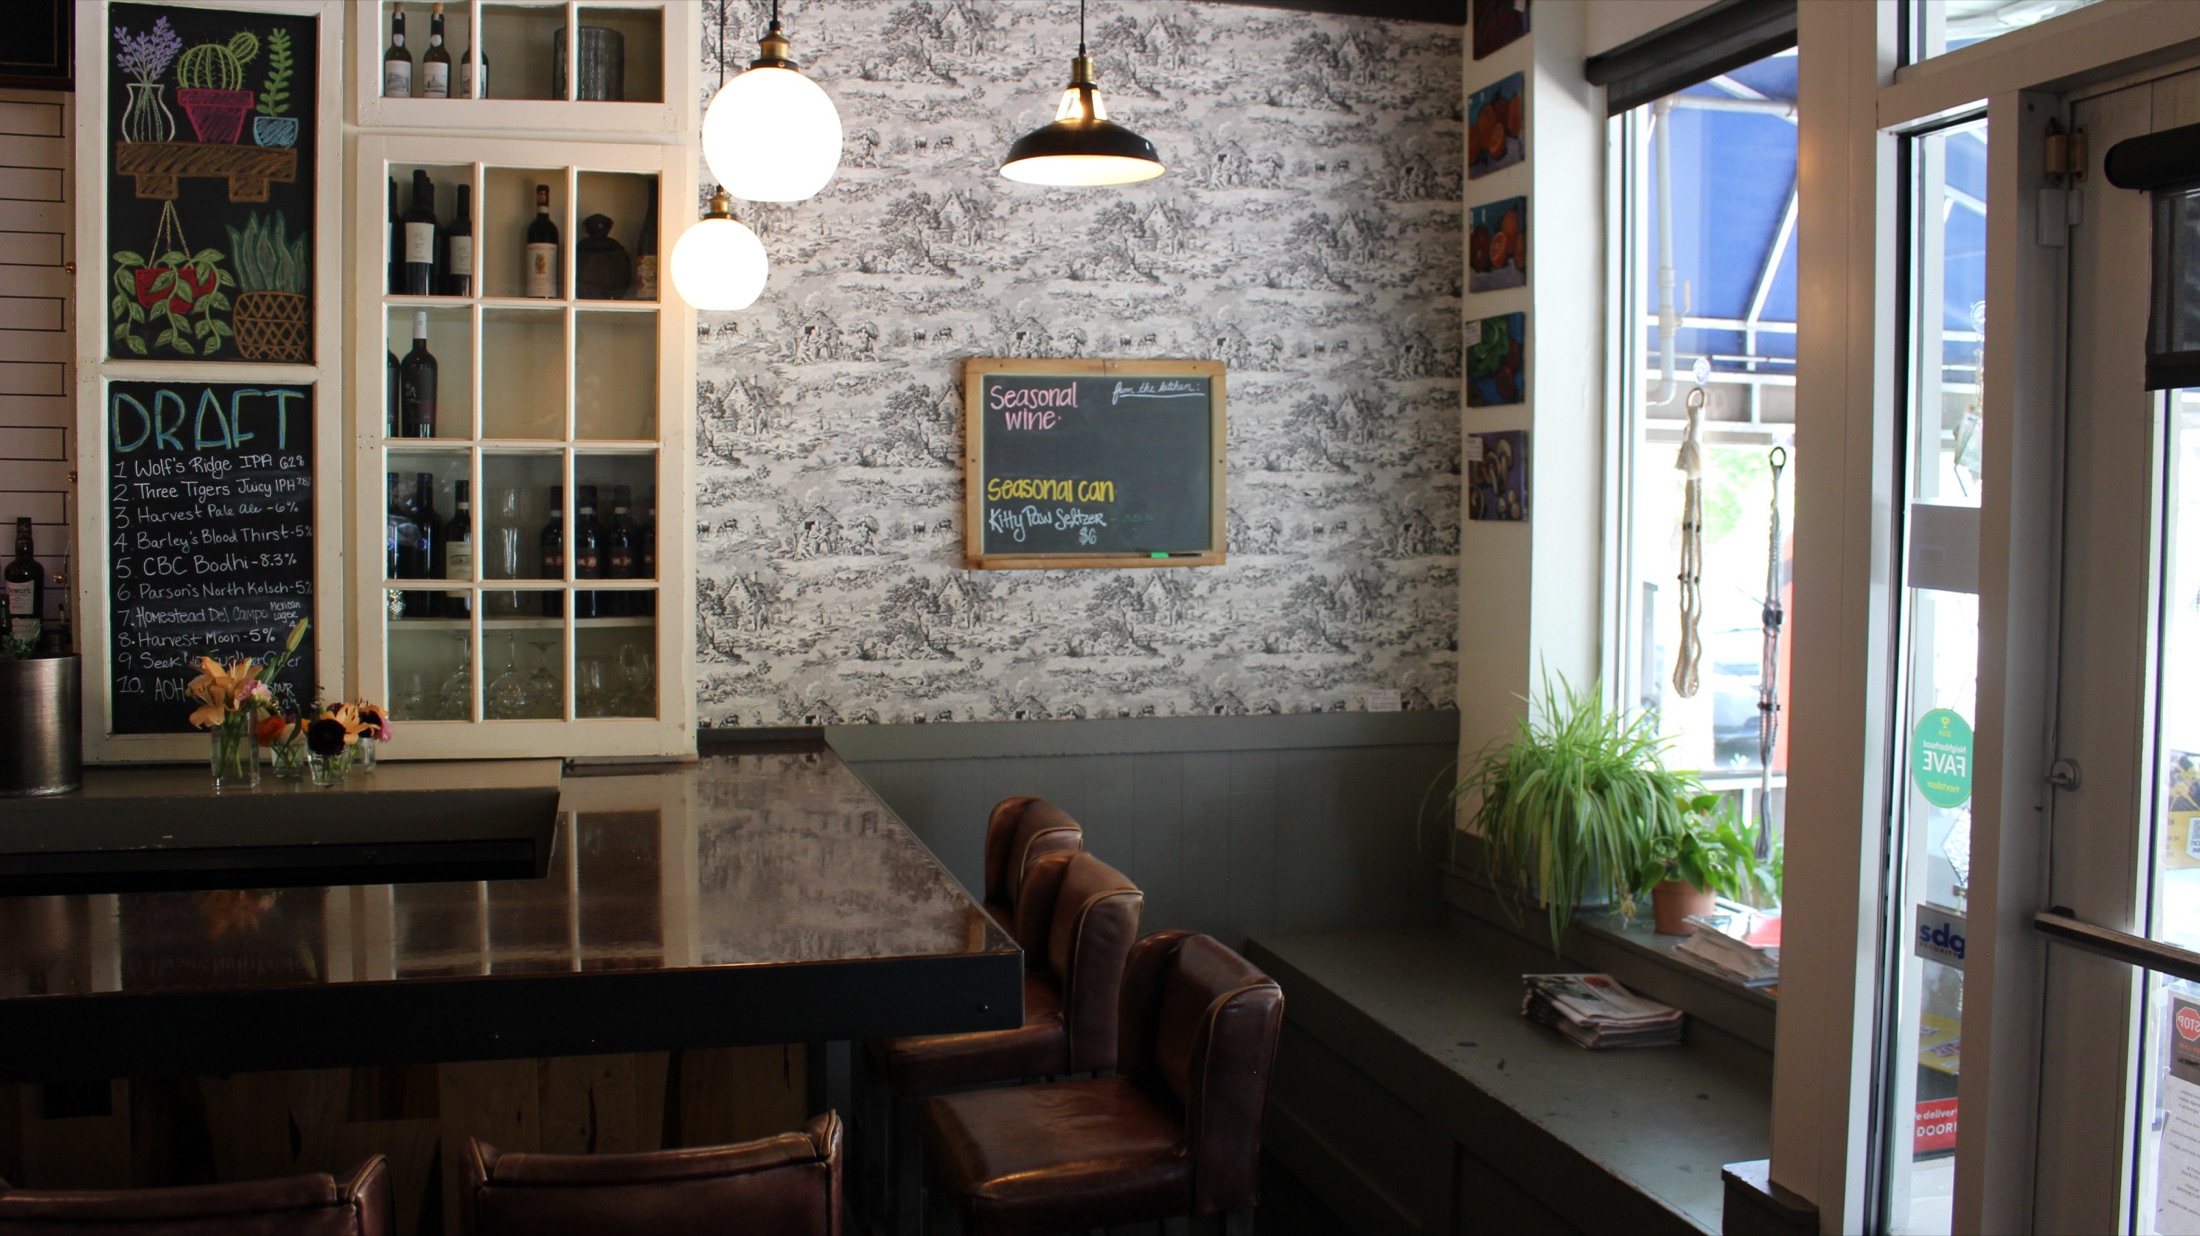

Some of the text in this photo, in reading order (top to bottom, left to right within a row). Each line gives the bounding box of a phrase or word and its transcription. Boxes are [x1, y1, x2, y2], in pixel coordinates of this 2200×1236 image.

[991, 381, 1078, 410] Seasonal
[1137, 381, 1155, 393] the
[112, 388, 305, 452] DRAFT
[114, 461, 127, 478] 1
[135, 457, 186, 477] Wolf's
[188, 455, 232, 480] Ridge
[238, 454, 273, 468] IPA
[133, 482, 179, 499] Three
[180, 480, 230, 503] Tigers
[236, 478, 272, 497] Juicy
[987, 478, 1115, 502] Seasonal can
[137, 503, 203, 523] Harvest
[207, 503, 235, 518] Pale
[239, 503, 262, 514] Ale
[989, 507, 1026, 543] Kitty
[1021, 505, 1053, 527] Paw
[137, 531, 199, 553] Barley's
[201, 528, 238, 544] Blood
[1079, 526, 1098, 545] $6
[143, 555, 188, 576] CBC
[139, 583, 200, 599] Parson's
[202, 581, 245, 598] North
[208, 607, 230, 623] Del
[233, 606, 268, 624] Campo
[138, 632, 202, 648] Harvest
[118, 652, 132, 670] 9
[140, 651, 183, 669] Seek
[1917, 1121, 1957, 1137] DOOR
